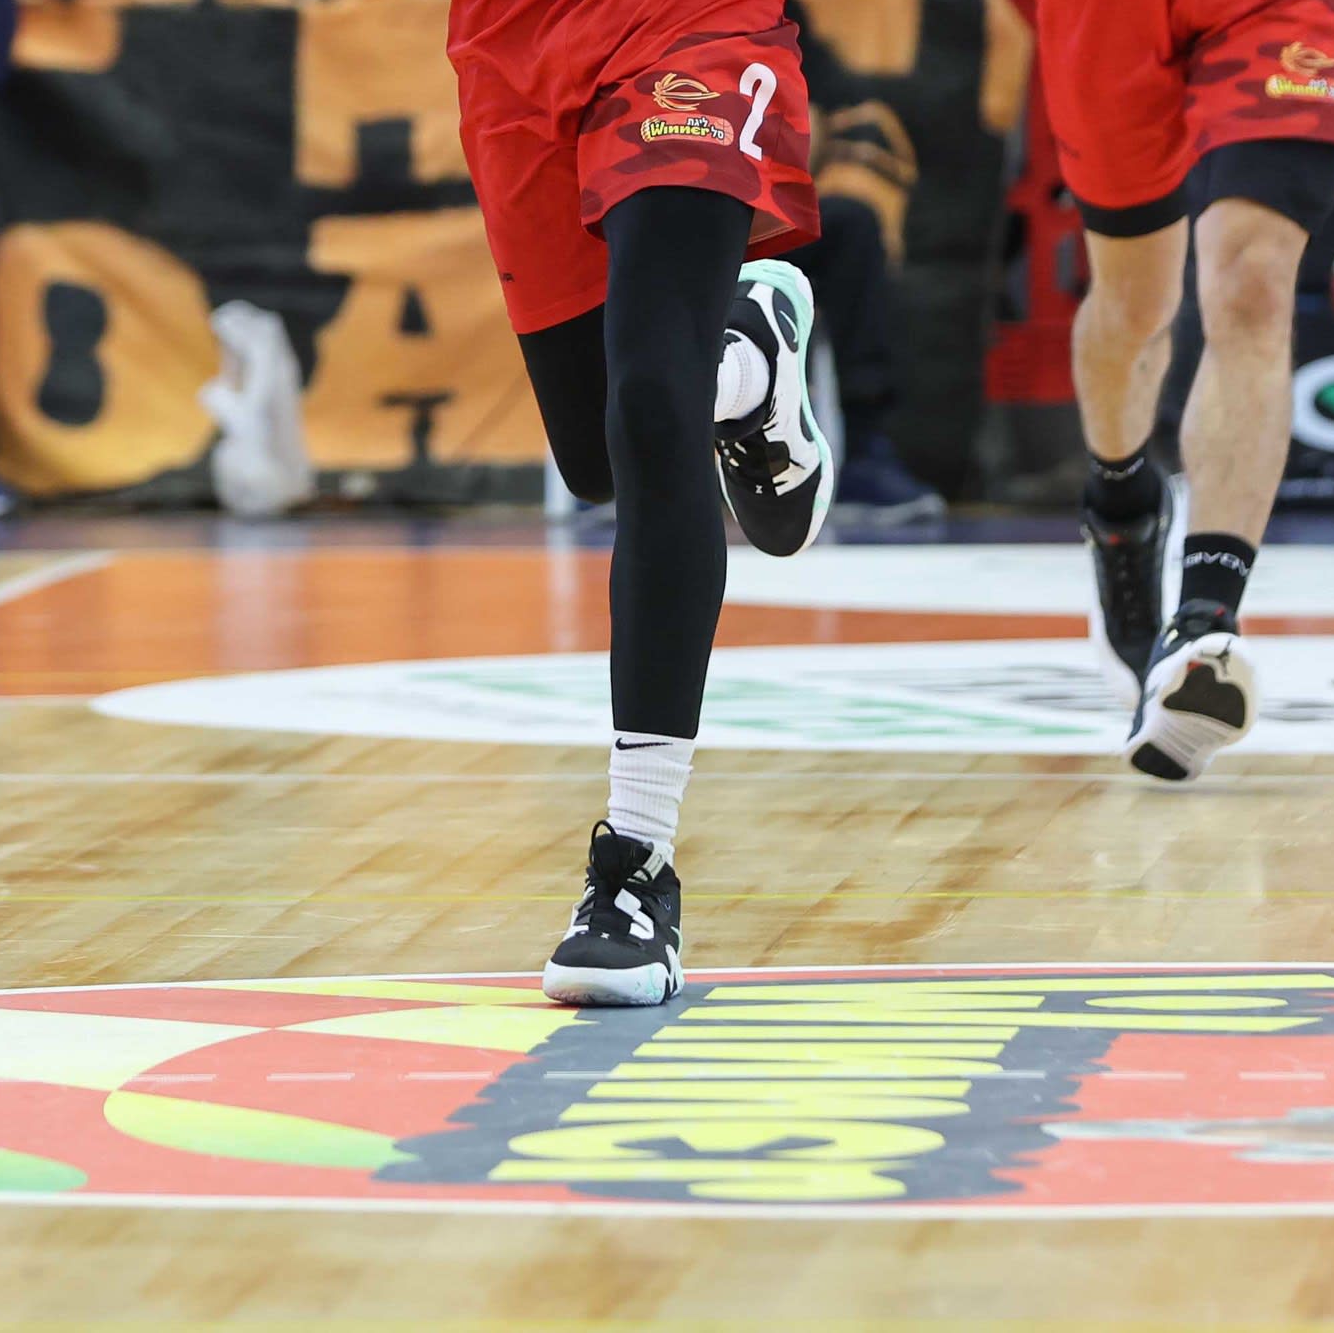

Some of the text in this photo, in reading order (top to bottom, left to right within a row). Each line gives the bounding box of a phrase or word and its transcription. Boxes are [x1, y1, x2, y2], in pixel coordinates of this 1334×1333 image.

[739, 62, 777, 162] 2
[650, 122, 710, 137] Winner
[686, 117, 709, 128] ליגת
[710, 127, 725, 140] סל
